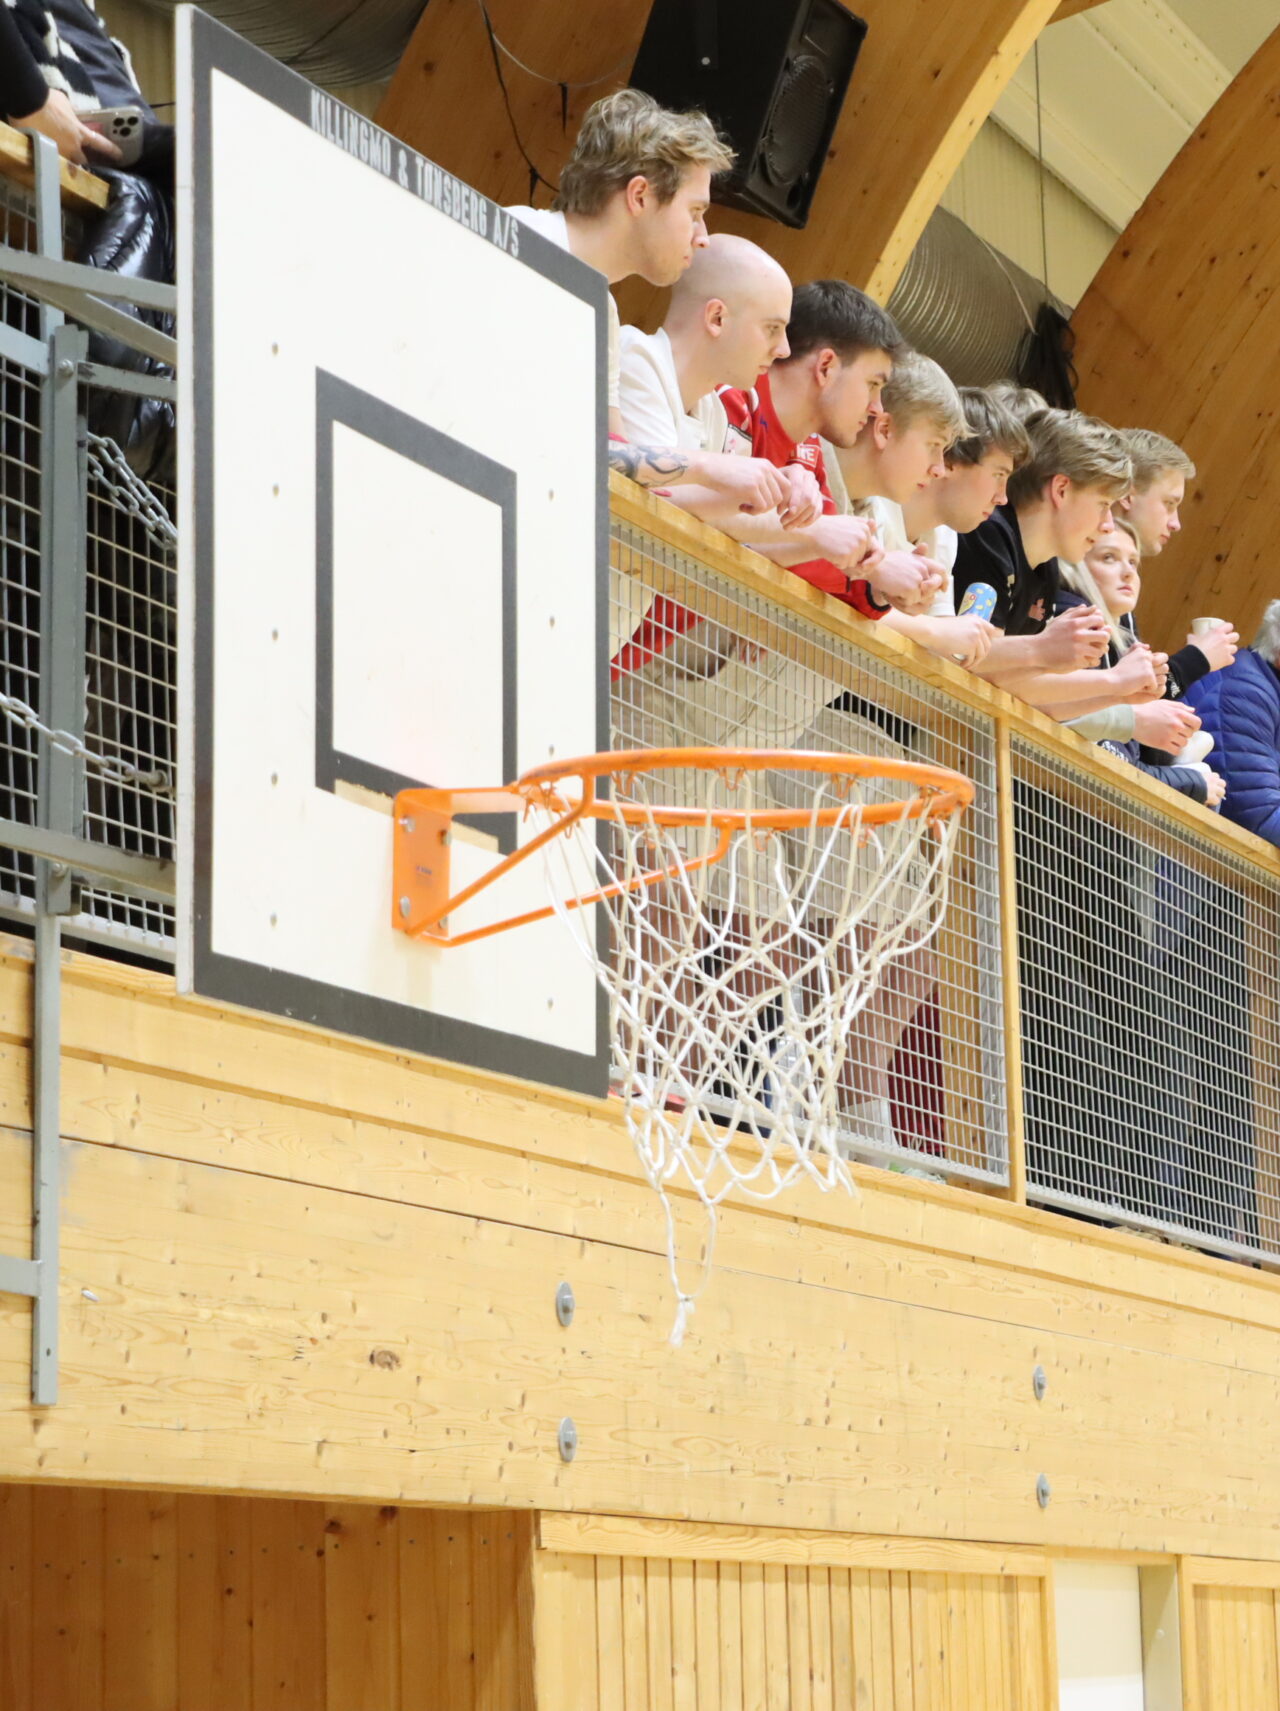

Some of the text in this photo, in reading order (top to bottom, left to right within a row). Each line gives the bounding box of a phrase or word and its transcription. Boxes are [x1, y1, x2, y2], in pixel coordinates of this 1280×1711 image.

[311, 89, 391, 176] KILLINGMO
[398, 149, 409, 188] &
[493, 208, 519, 258] A/S
